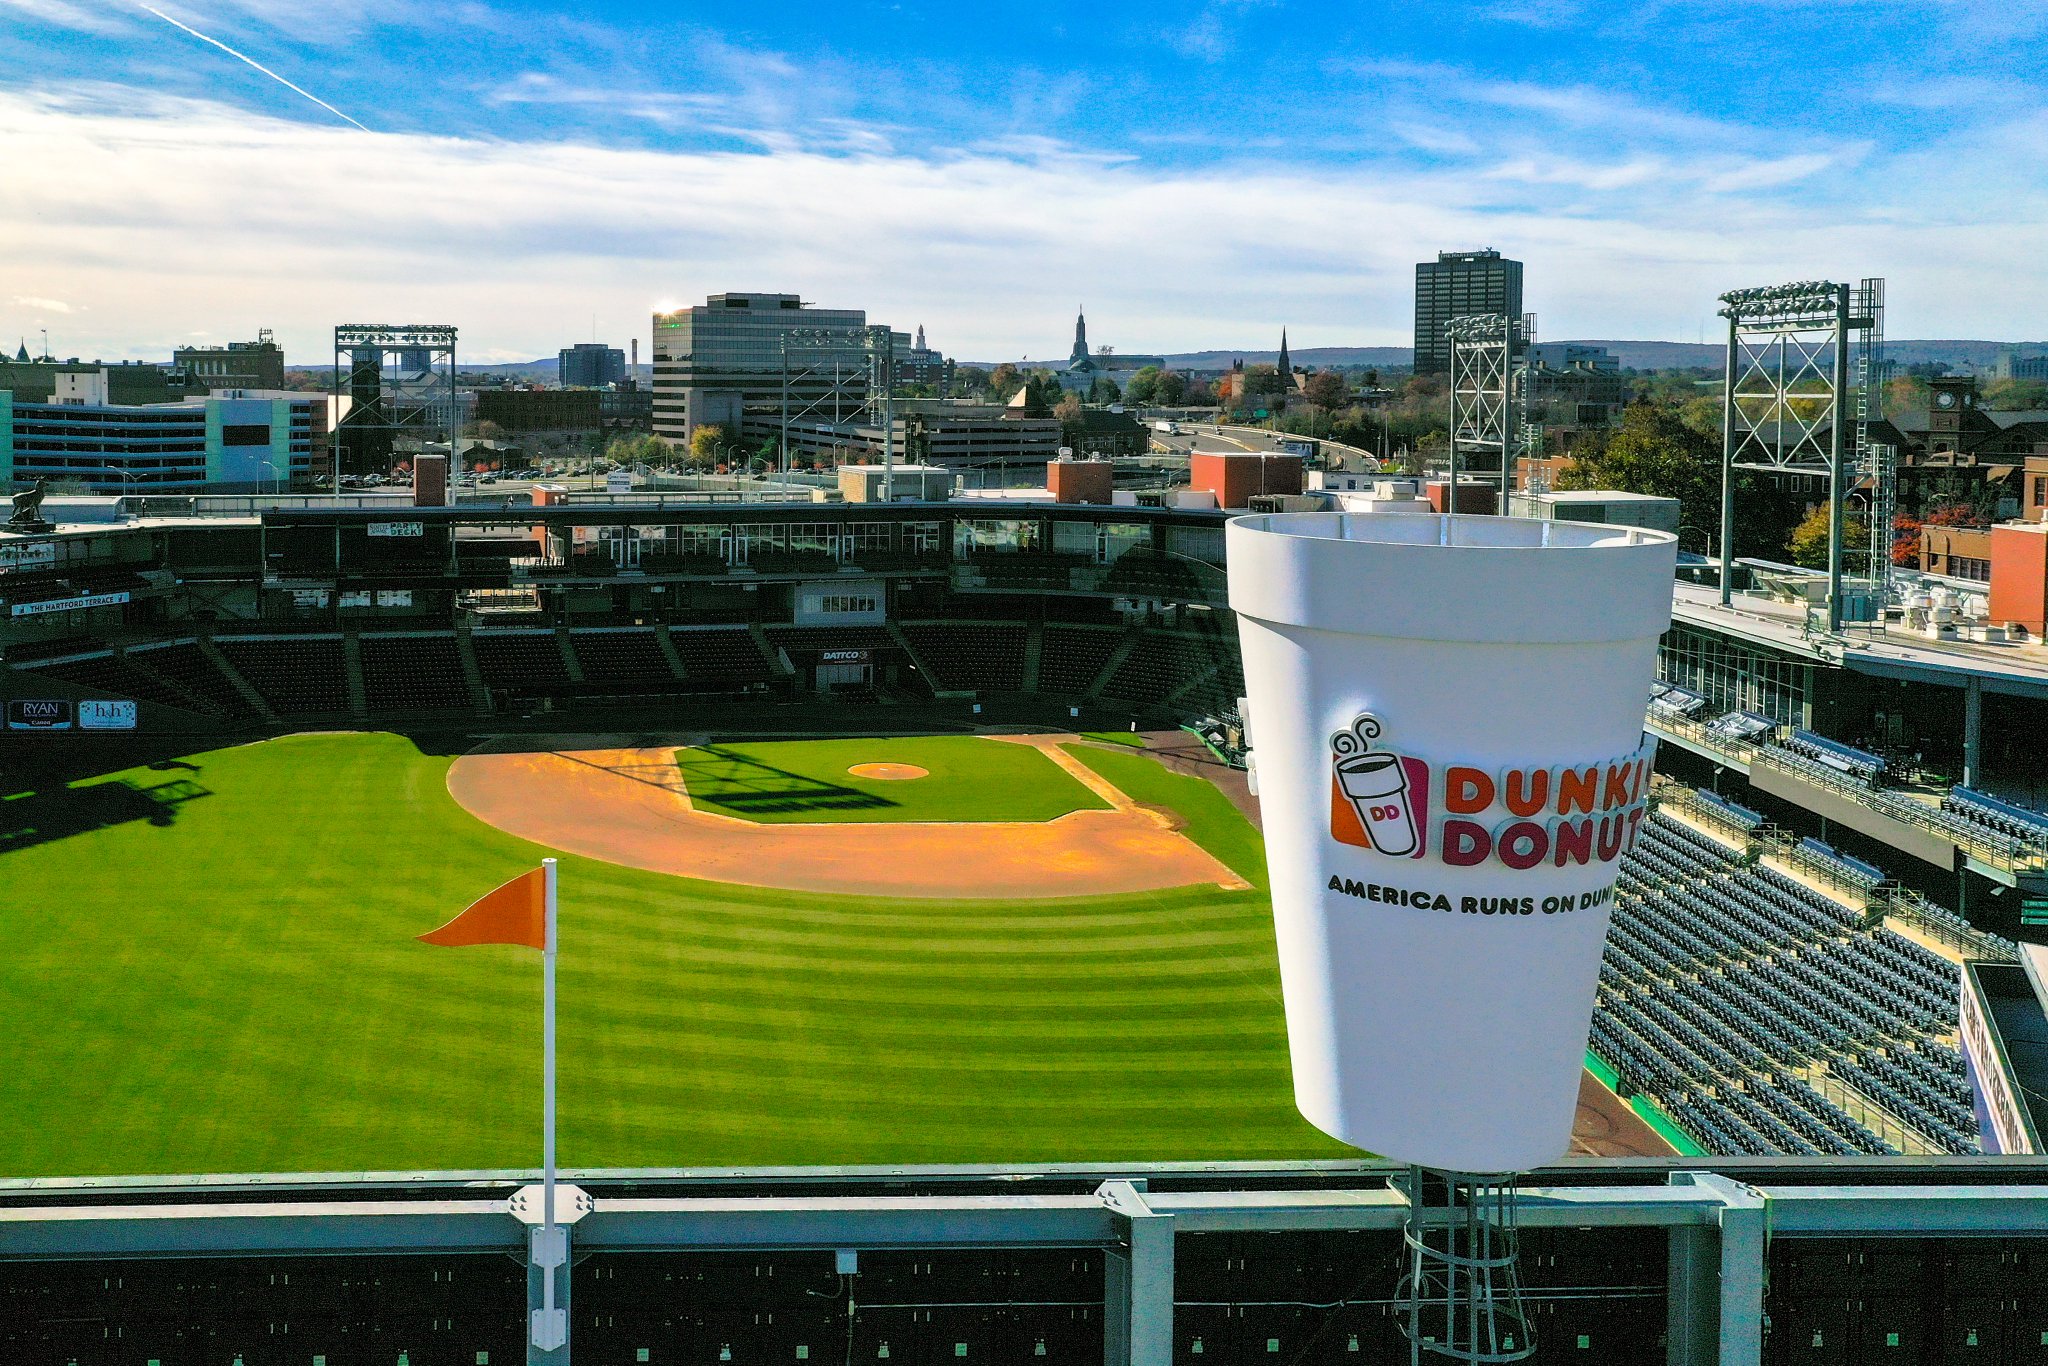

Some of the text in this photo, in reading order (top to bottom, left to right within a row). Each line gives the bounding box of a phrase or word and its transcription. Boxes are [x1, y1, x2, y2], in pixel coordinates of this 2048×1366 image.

[30, 596, 114, 613] THE HARTFORD TERRACE
[823, 651, 859, 659] DATTCO
[23, 703, 58, 714] RYAN
[1445, 757, 1655, 818] DUNKI
[1369, 804, 1400, 822] DD
[1328, 875, 1452, 912] AMERICA
[1461, 896, 1534, 915] RUNS
[1541, 895, 1576, 914] ON
